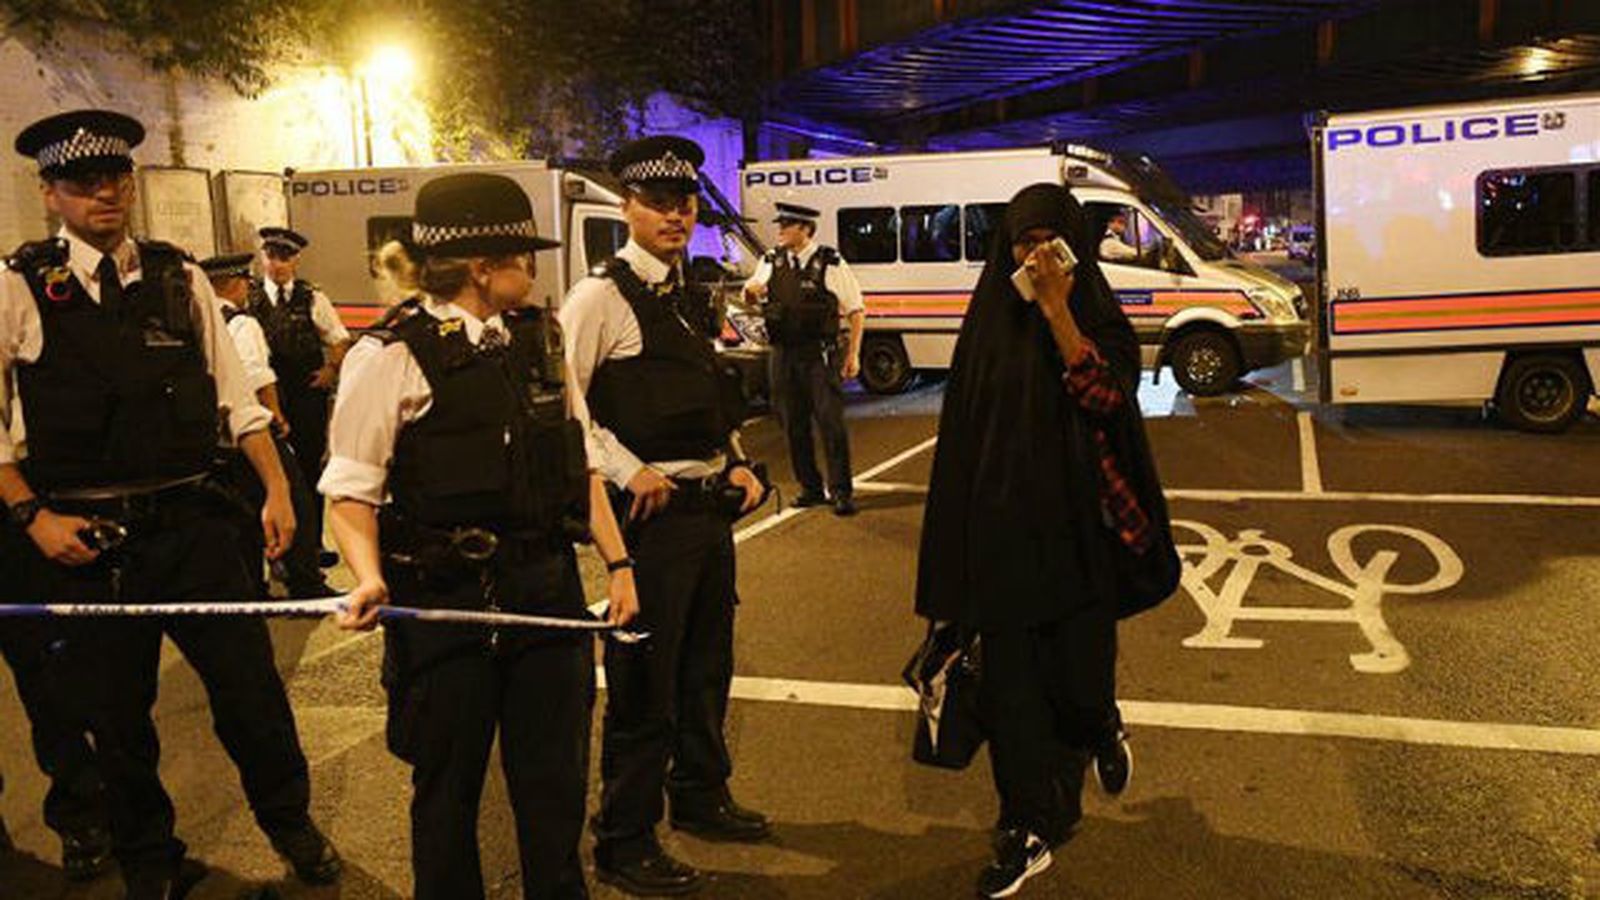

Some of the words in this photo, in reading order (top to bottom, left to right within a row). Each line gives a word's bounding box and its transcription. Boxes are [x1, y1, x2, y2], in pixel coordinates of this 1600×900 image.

[1327, 114, 1539, 150] POLICE
[745, 166, 872, 187] POLICE
[292, 178, 397, 197] POLICE
